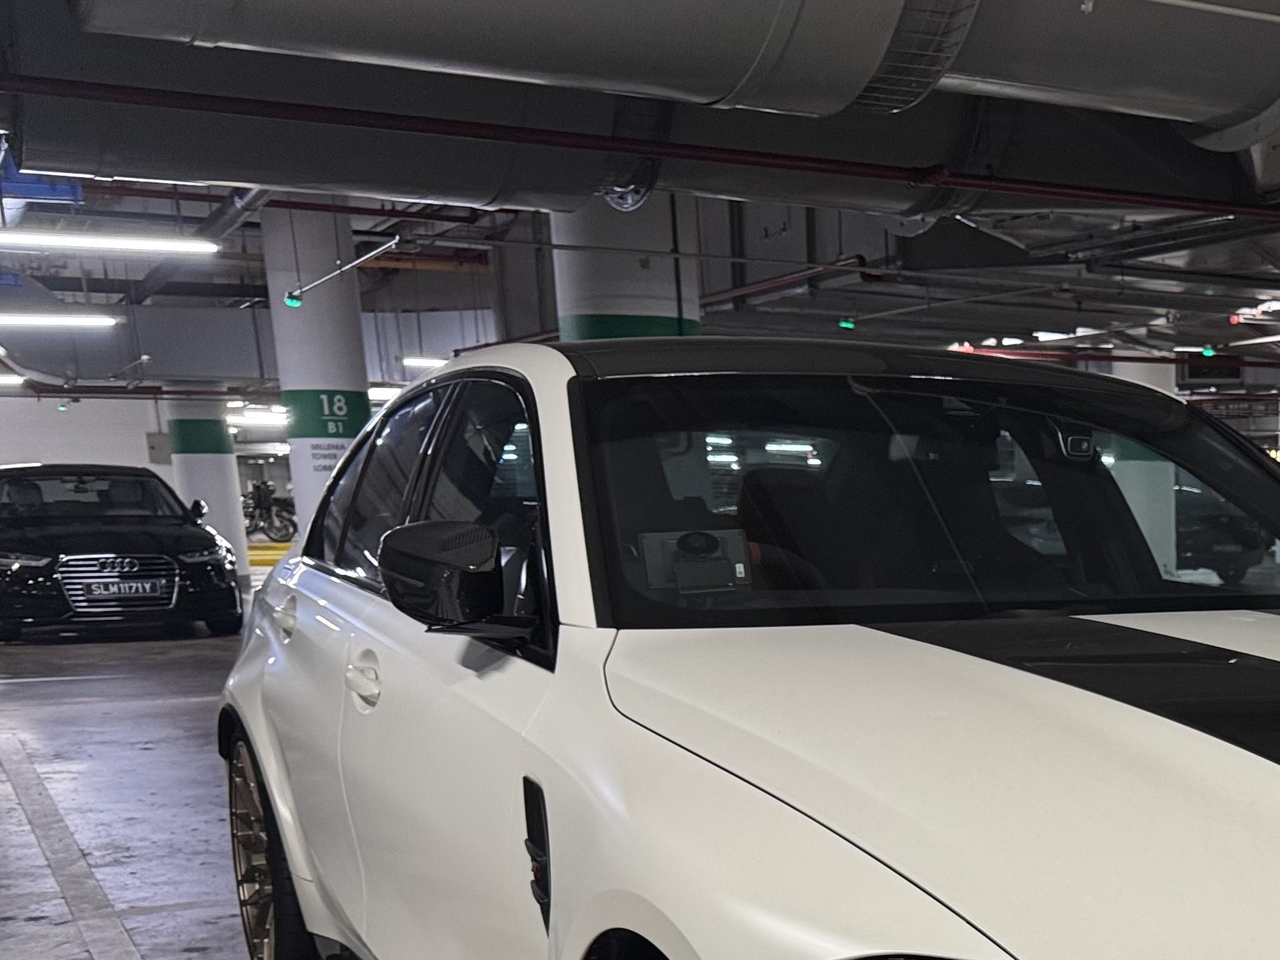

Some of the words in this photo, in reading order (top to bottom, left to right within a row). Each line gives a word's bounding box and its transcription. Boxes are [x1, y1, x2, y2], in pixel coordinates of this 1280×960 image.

[320, 394, 348, 416] 18
[327, 421, 344, 434] B1
[91, 582, 152, 595] SLM1171Y
